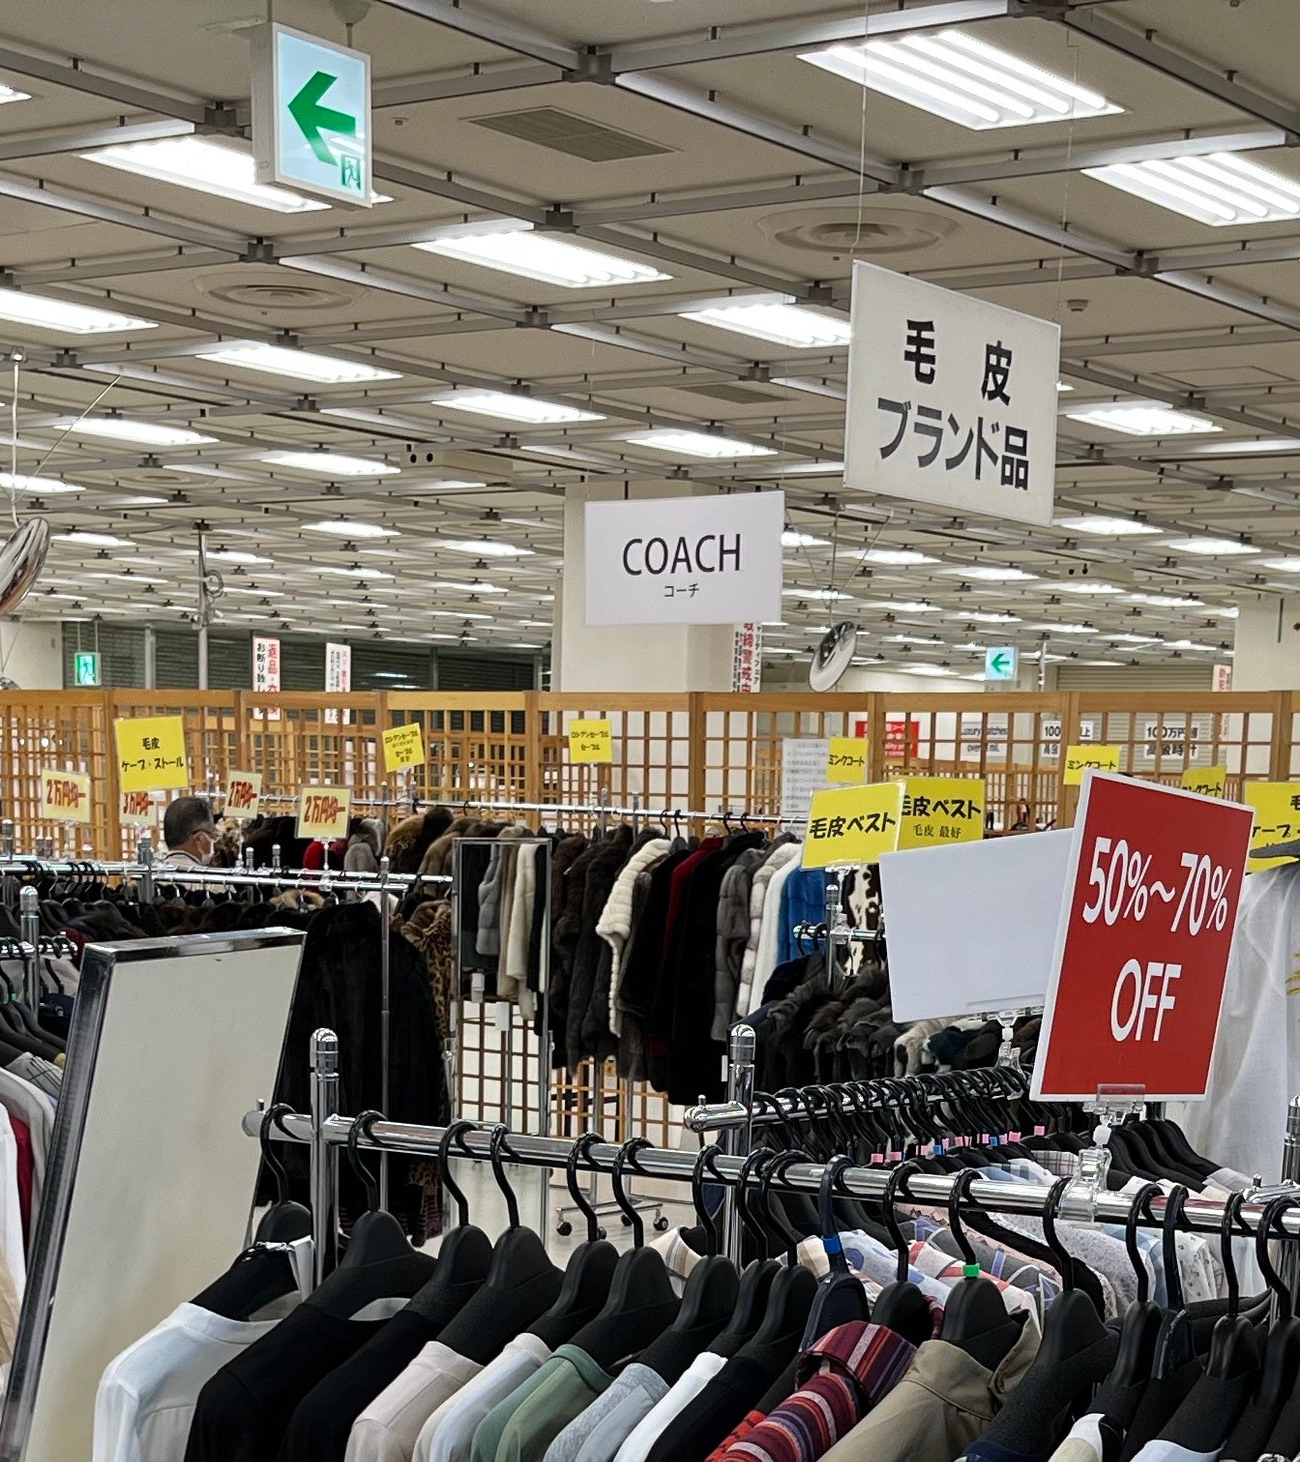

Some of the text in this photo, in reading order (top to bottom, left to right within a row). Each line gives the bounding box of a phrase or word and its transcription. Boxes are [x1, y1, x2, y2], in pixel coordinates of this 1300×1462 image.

[877, 397, 1030, 491] ブランド品
[622, 533, 742, 576] COACH
[663, 583, 701, 598] コーチ
[142, 737, 161, 750] 毛皮
[828, 753, 865, 767] ミンクコート
[1067, 759, 1117, 771] ミンクコート
[808, 811, 897, 840] 毛皮ベスト
[913, 824, 935, 838] 毛皮
[1110, 958, 1182, 1042] OFF
